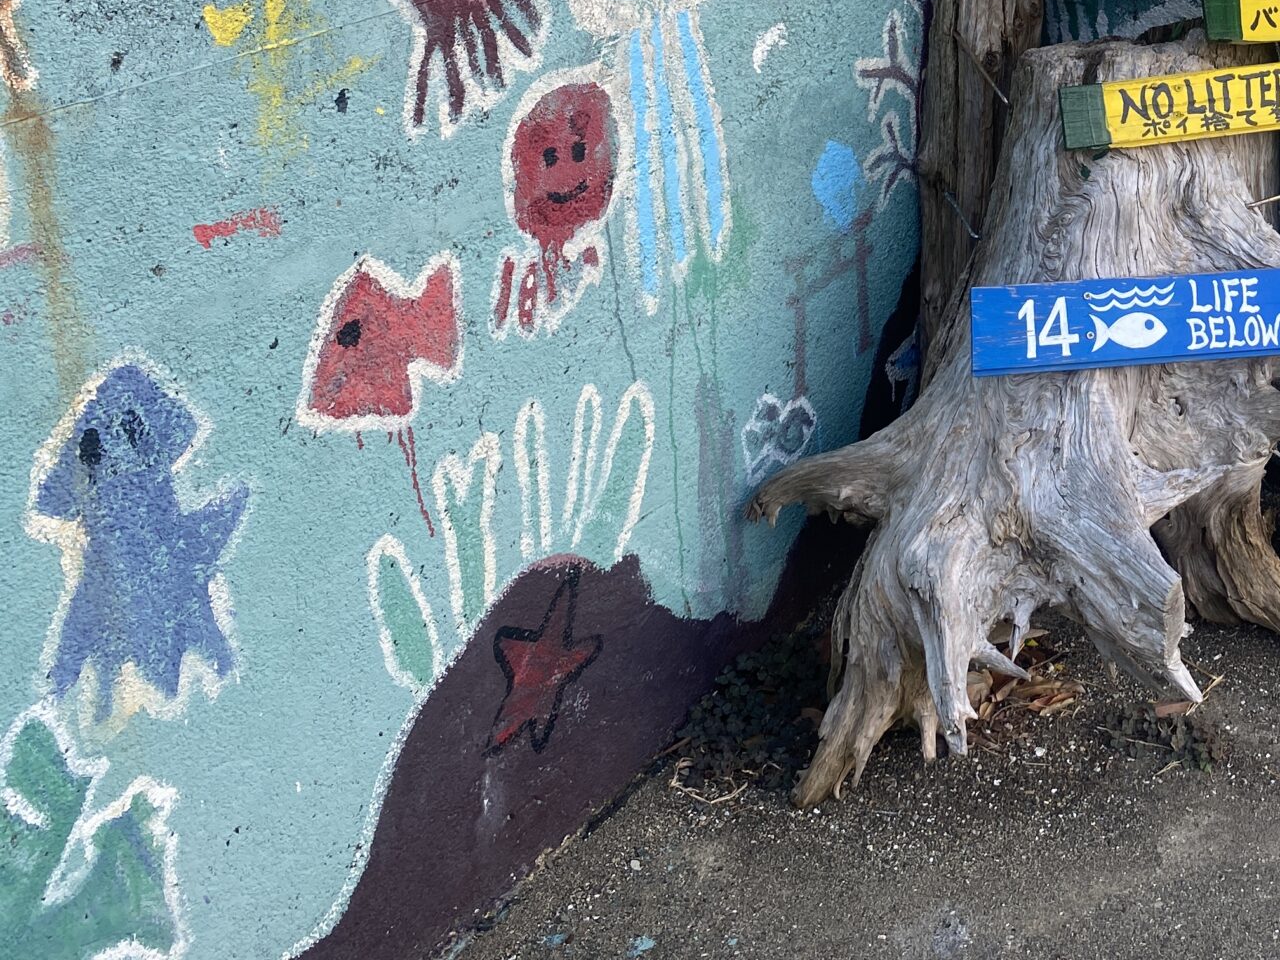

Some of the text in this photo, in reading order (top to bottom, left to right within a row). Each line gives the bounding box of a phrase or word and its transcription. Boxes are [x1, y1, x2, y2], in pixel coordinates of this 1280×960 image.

[1119, 82, 1174, 123] NO
[1187, 277, 1260, 314] LIFE
[1017, 296, 1080, 359] 14
